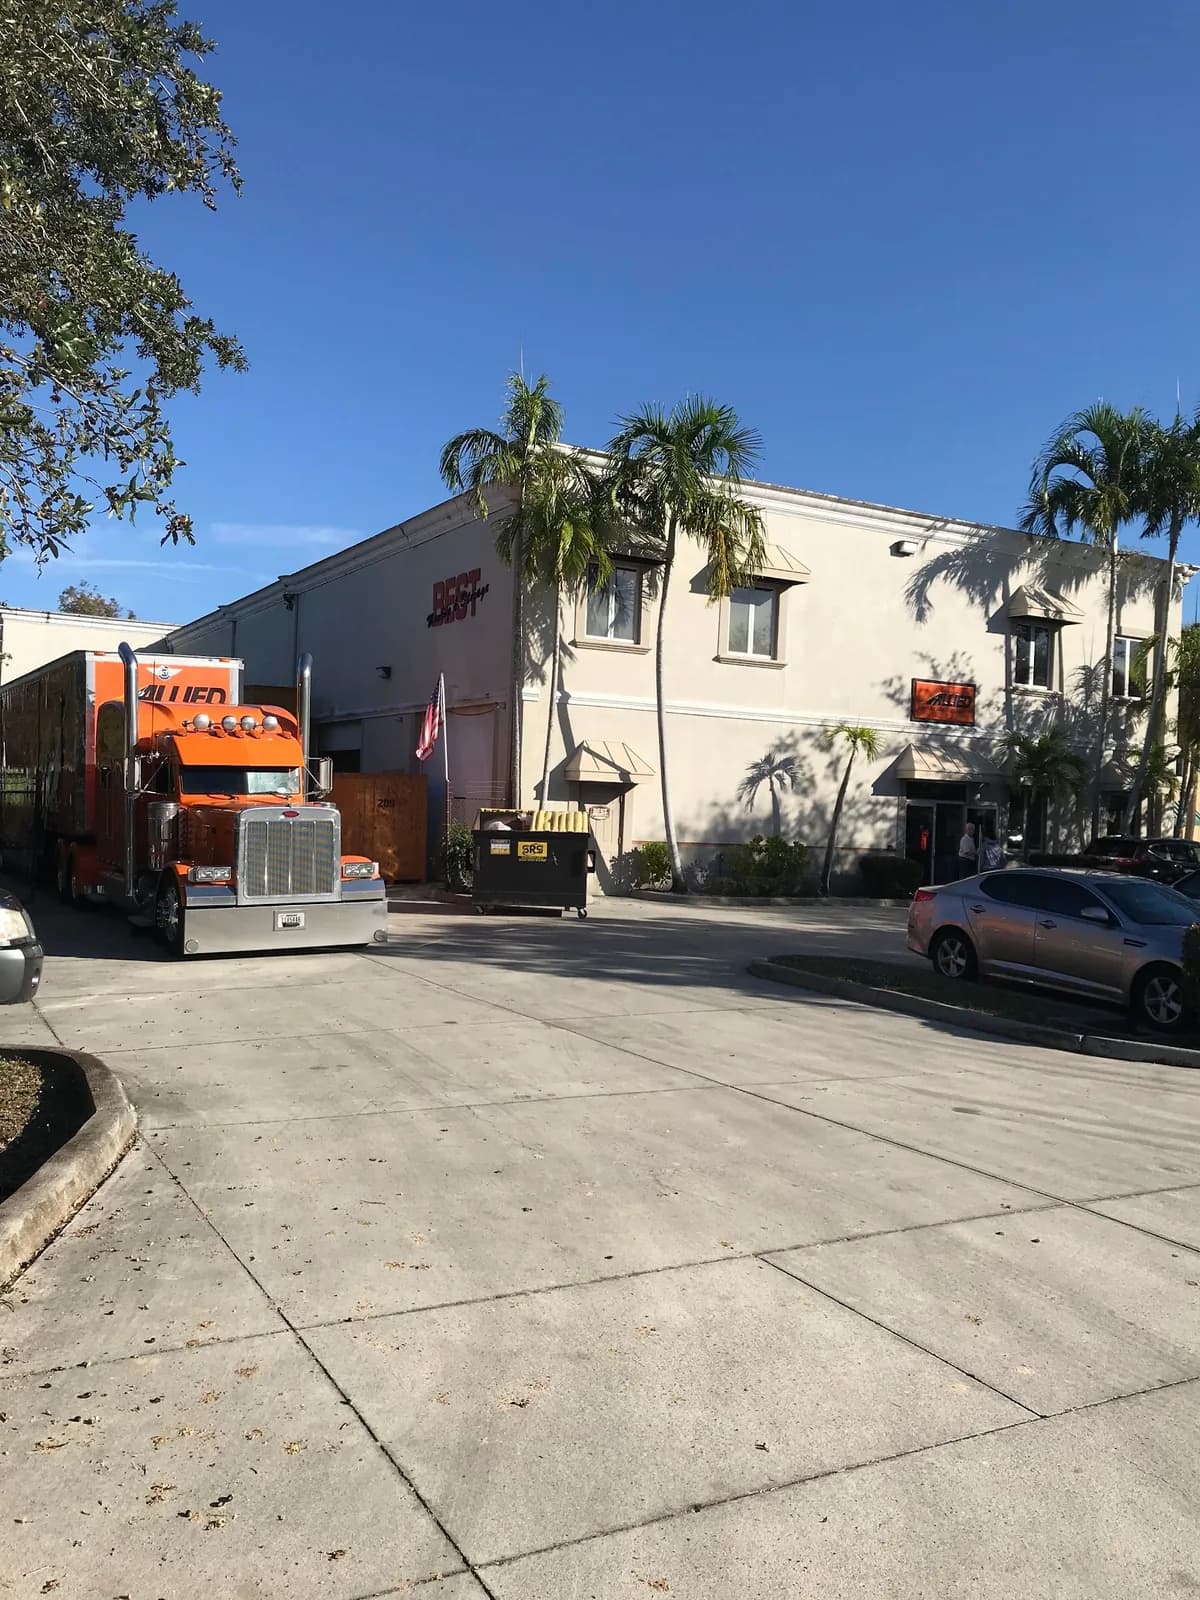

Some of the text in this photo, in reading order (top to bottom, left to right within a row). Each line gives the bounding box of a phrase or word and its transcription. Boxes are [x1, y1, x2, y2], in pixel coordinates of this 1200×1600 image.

[432, 568, 481, 627] BEST
[137, 684, 226, 704] ALLIED
[925, 693, 971, 707] ALLIED
[522, 844, 543, 855] SRS
